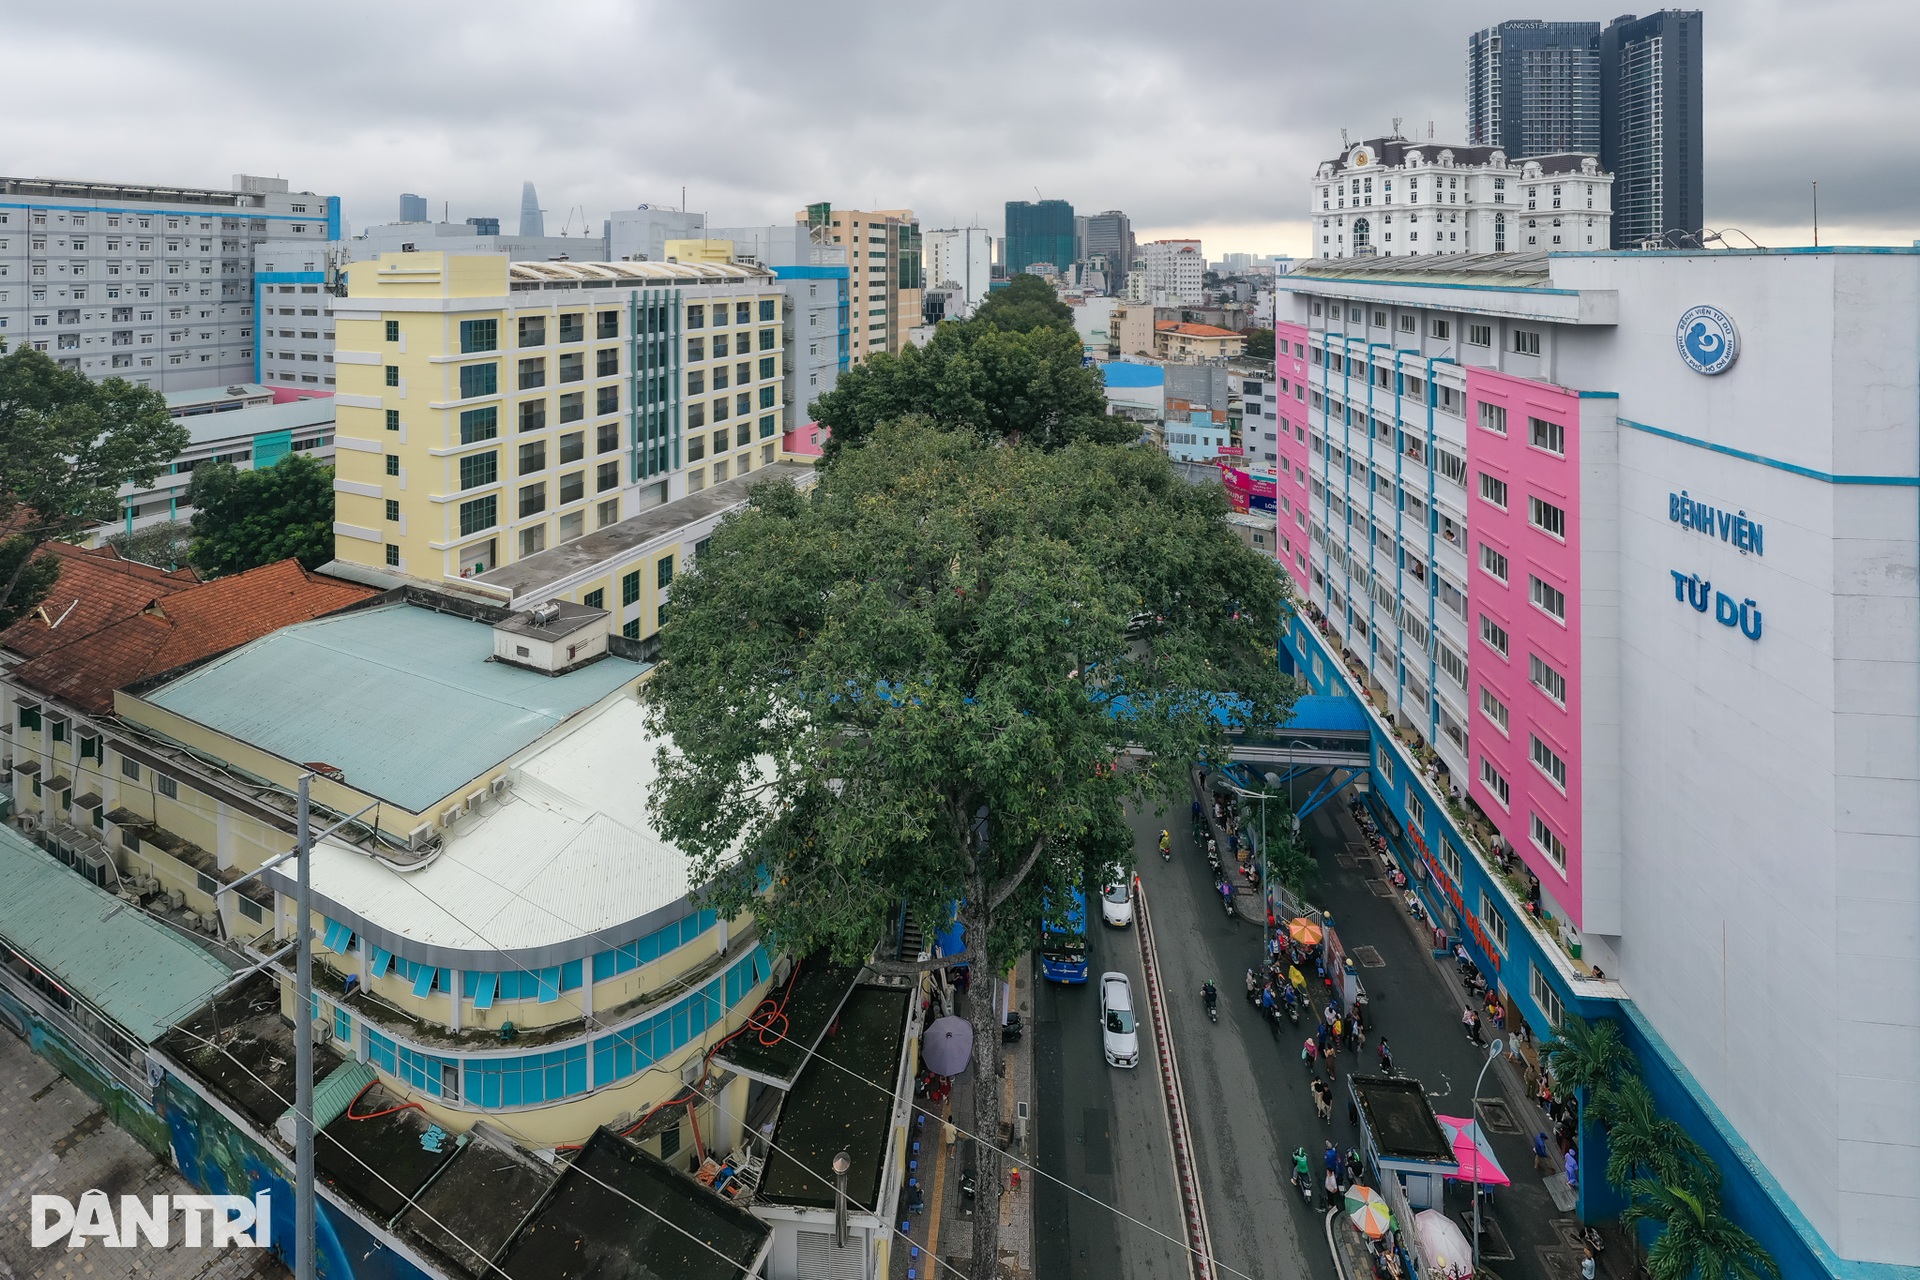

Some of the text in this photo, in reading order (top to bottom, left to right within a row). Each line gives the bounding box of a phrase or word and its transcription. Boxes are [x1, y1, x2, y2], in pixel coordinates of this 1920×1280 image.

[1504, 22, 1549, 30] LANCASTER
[1724, 339, 1733, 360] MINH
[1669, 490, 1764, 557] BỆNH VIỆN
[1670, 569, 1762, 641] TỪ DŨ
[1407, 819, 1501, 973] KHU KHÁM BỆNH
